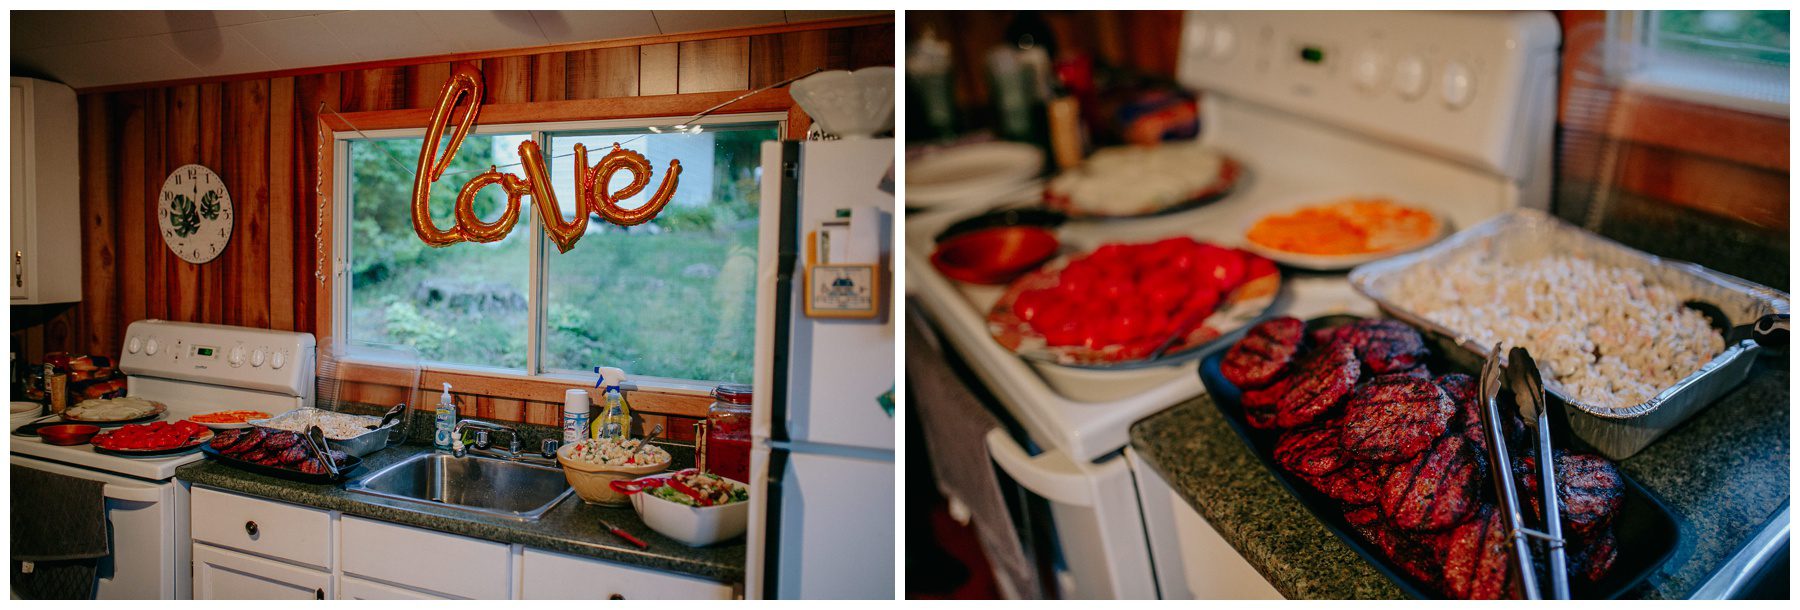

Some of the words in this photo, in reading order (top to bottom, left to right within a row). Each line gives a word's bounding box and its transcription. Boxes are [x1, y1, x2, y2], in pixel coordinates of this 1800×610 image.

[411, 65, 683, 254] love
[188, 169, 197, 179] 12
[205, 173, 209, 183] 1
[175, 175, 182, 184] 11
[164, 191, 173, 201] 10
[216, 187, 223, 198] 2
[160, 208, 167, 218] 9
[223, 209, 230, 219] 3
[166, 230, 173, 238] 8
[217, 228, 226, 238] 4
[178, 243, 185, 254] 7
[193, 248, 200, 259] 6
[210, 243, 216, 254] 5
